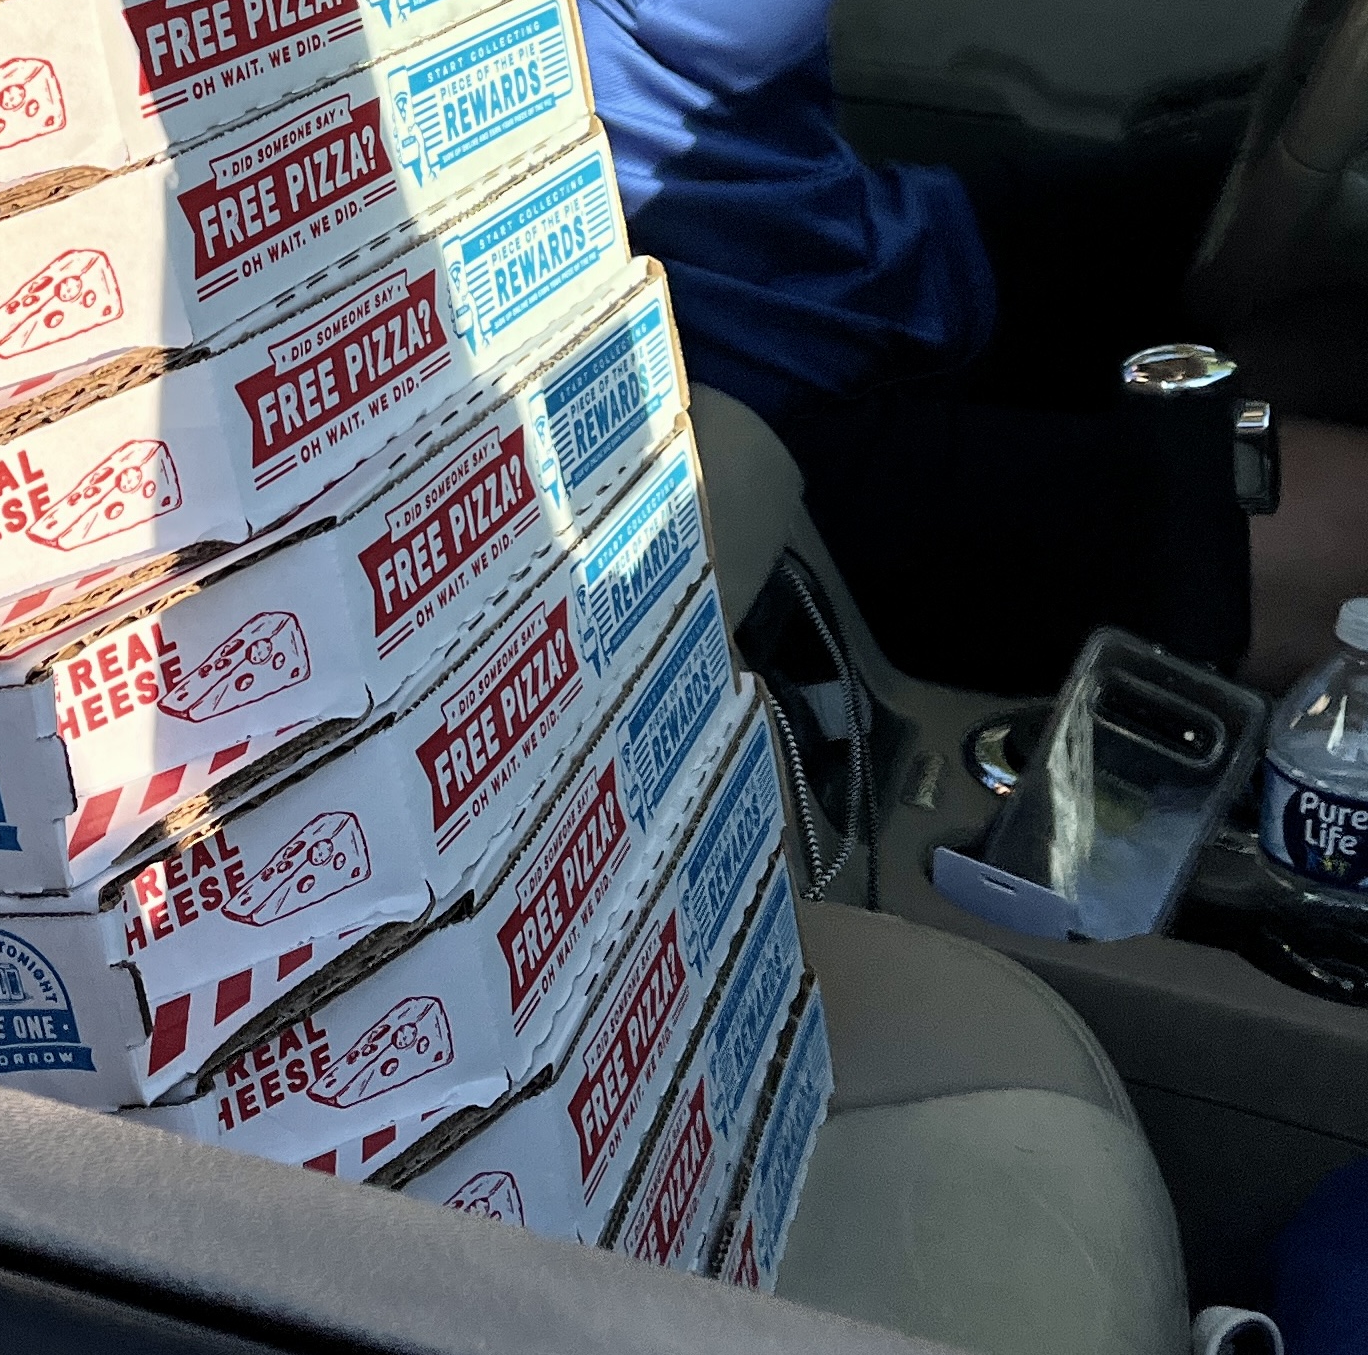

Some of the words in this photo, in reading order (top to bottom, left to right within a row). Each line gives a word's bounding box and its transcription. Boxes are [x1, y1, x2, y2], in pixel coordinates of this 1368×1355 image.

[146, 0, 236, 77] FREE
[443, 59, 541, 142] REWARDS
[199, 176, 280, 259] FREE
[285, 124, 375, 213] PIZZA?
[495, 214, 586, 307] REWARDS
[258, 357, 339, 447] FREE
[344, 299, 432, 393] PIZZA?
[574, 362, 650, 459] REWARDS
[378, 520, 447, 614] FREE
[448, 454, 523, 554] PIZZA?
[57, 656, 183, 740] HEESE
[68, 623, 177, 696] REAL
[436, 705, 499, 808] FREE
[500, 629, 567, 737] PIZZA?
[1300, 791, 1368, 830] Pure
[124, 860, 246, 956] HEESE
[133, 828, 239, 905] REAL
[512, 878, 563, 989] FREE
[562, 791, 616, 908] PIZZA?
[12, 1015, 56, 1038] ONE
[225, 1016, 326, 1086] REAL
[581, 1040, 628, 1156] FREE
[627, 942, 677, 1067] PIZZA?
